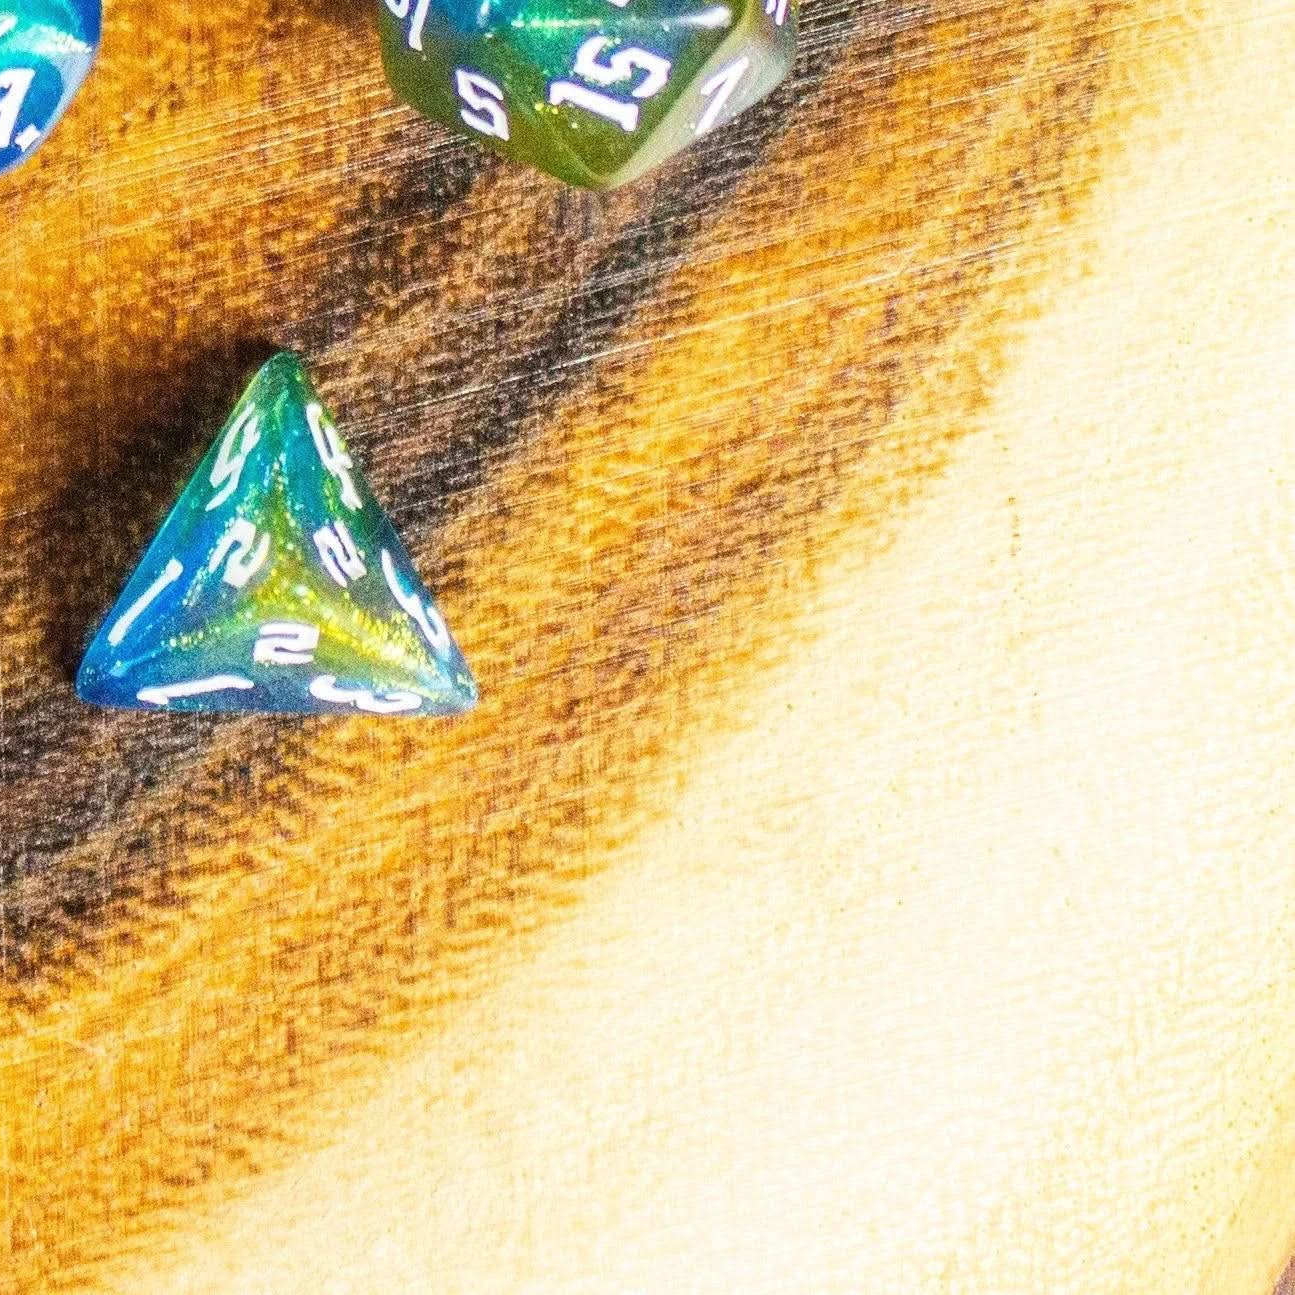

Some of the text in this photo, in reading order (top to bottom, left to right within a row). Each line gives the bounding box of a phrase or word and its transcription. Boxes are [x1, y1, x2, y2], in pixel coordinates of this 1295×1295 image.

[455, 68, 510, 141] 5
[549, 35, 672, 132] 15
[209, 517, 271, 589] 2
[312, 520, 367, 588] 2
[108, 558, 183, 647] 1
[252, 620, 320, 665] 2
[136, 674, 255, 705] 1
